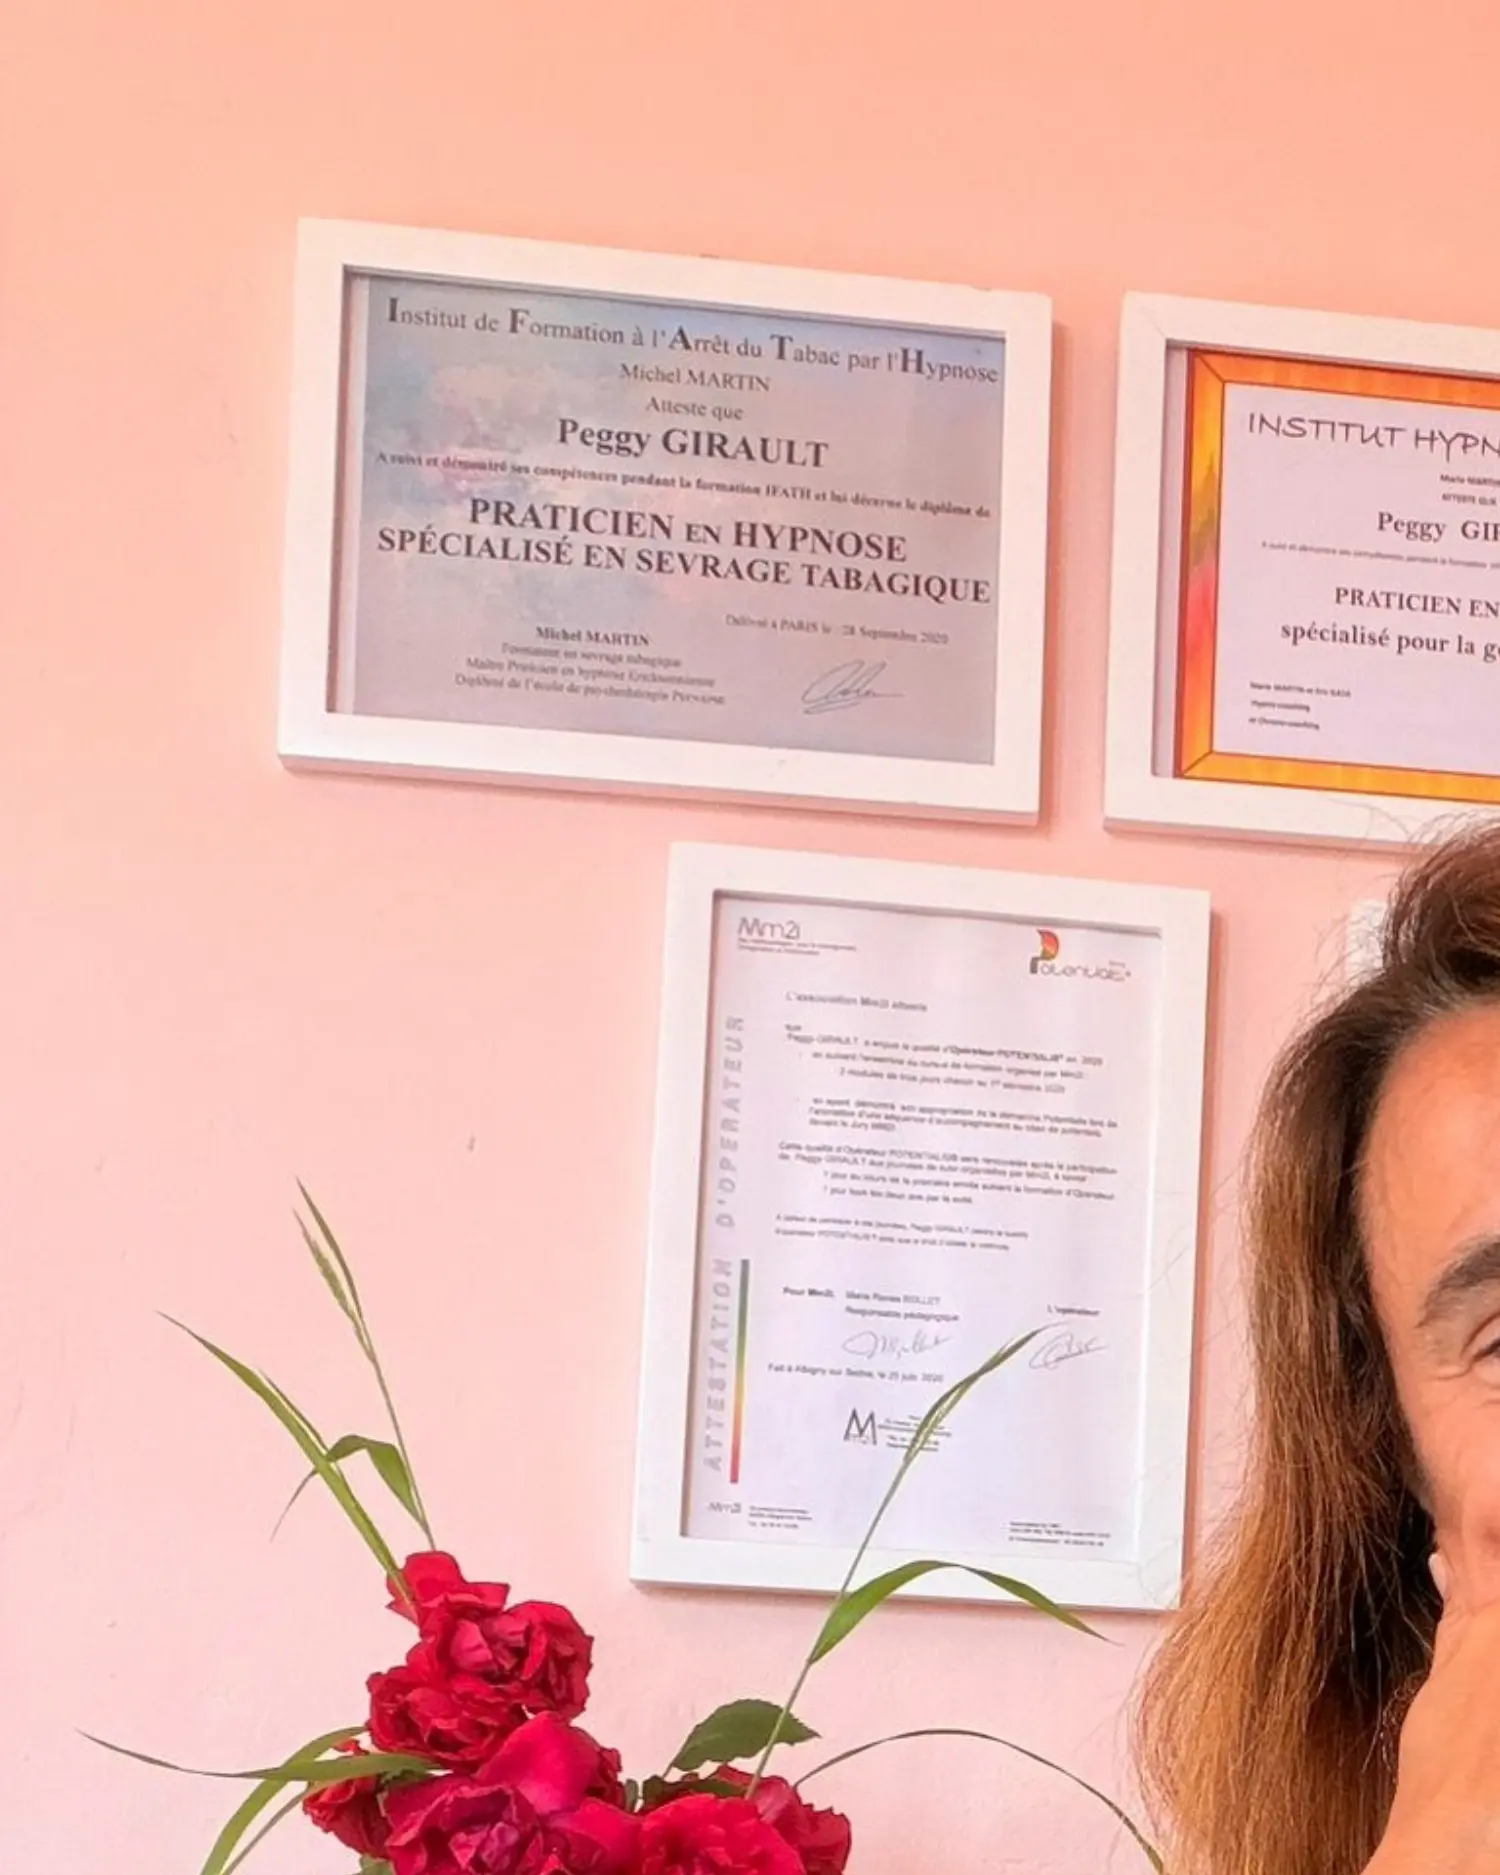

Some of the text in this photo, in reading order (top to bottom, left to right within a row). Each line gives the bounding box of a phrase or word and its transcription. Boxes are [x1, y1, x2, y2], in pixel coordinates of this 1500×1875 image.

[388, 297, 467, 329] Institut
[475, 312, 499, 333] de
[508, 308, 624, 345] Formation
[631, 326, 644, 347] à
[736, 338, 763, 358] du
[769, 334, 841, 365] Tabac
[847, 352, 881, 373] par
[887, 347, 1000, 383] l'Hypnose
[619, 362, 772, 392] Michel MARTIN
[645, 396, 744, 421] Atteste que
[559, 418, 830, 468] Peggy GIRAULT
[1249, 412, 1407, 448] INSTITUT
[621, 472, 676, 489] pendant
[679, 477, 693, 488] la
[695, 478, 761, 496] formation
[470, 498, 907, 562] PRATICIEN EN HYPNOSE
[1378, 511, 1446, 543] Peggy
[378, 524, 991, 604] SPÉCIALISÉ EN SEVRAGE TABAGIQUE
[1335, 586, 1462, 616] PRATICIEN
[1469, 599, 1500, 618] EN
[536, 626, 650, 646] Michel MARTIN
[1281, 620, 1390, 648] spécialisé
[1396, 633, 1450, 655] pour
[1457, 635, 1475, 655] la
